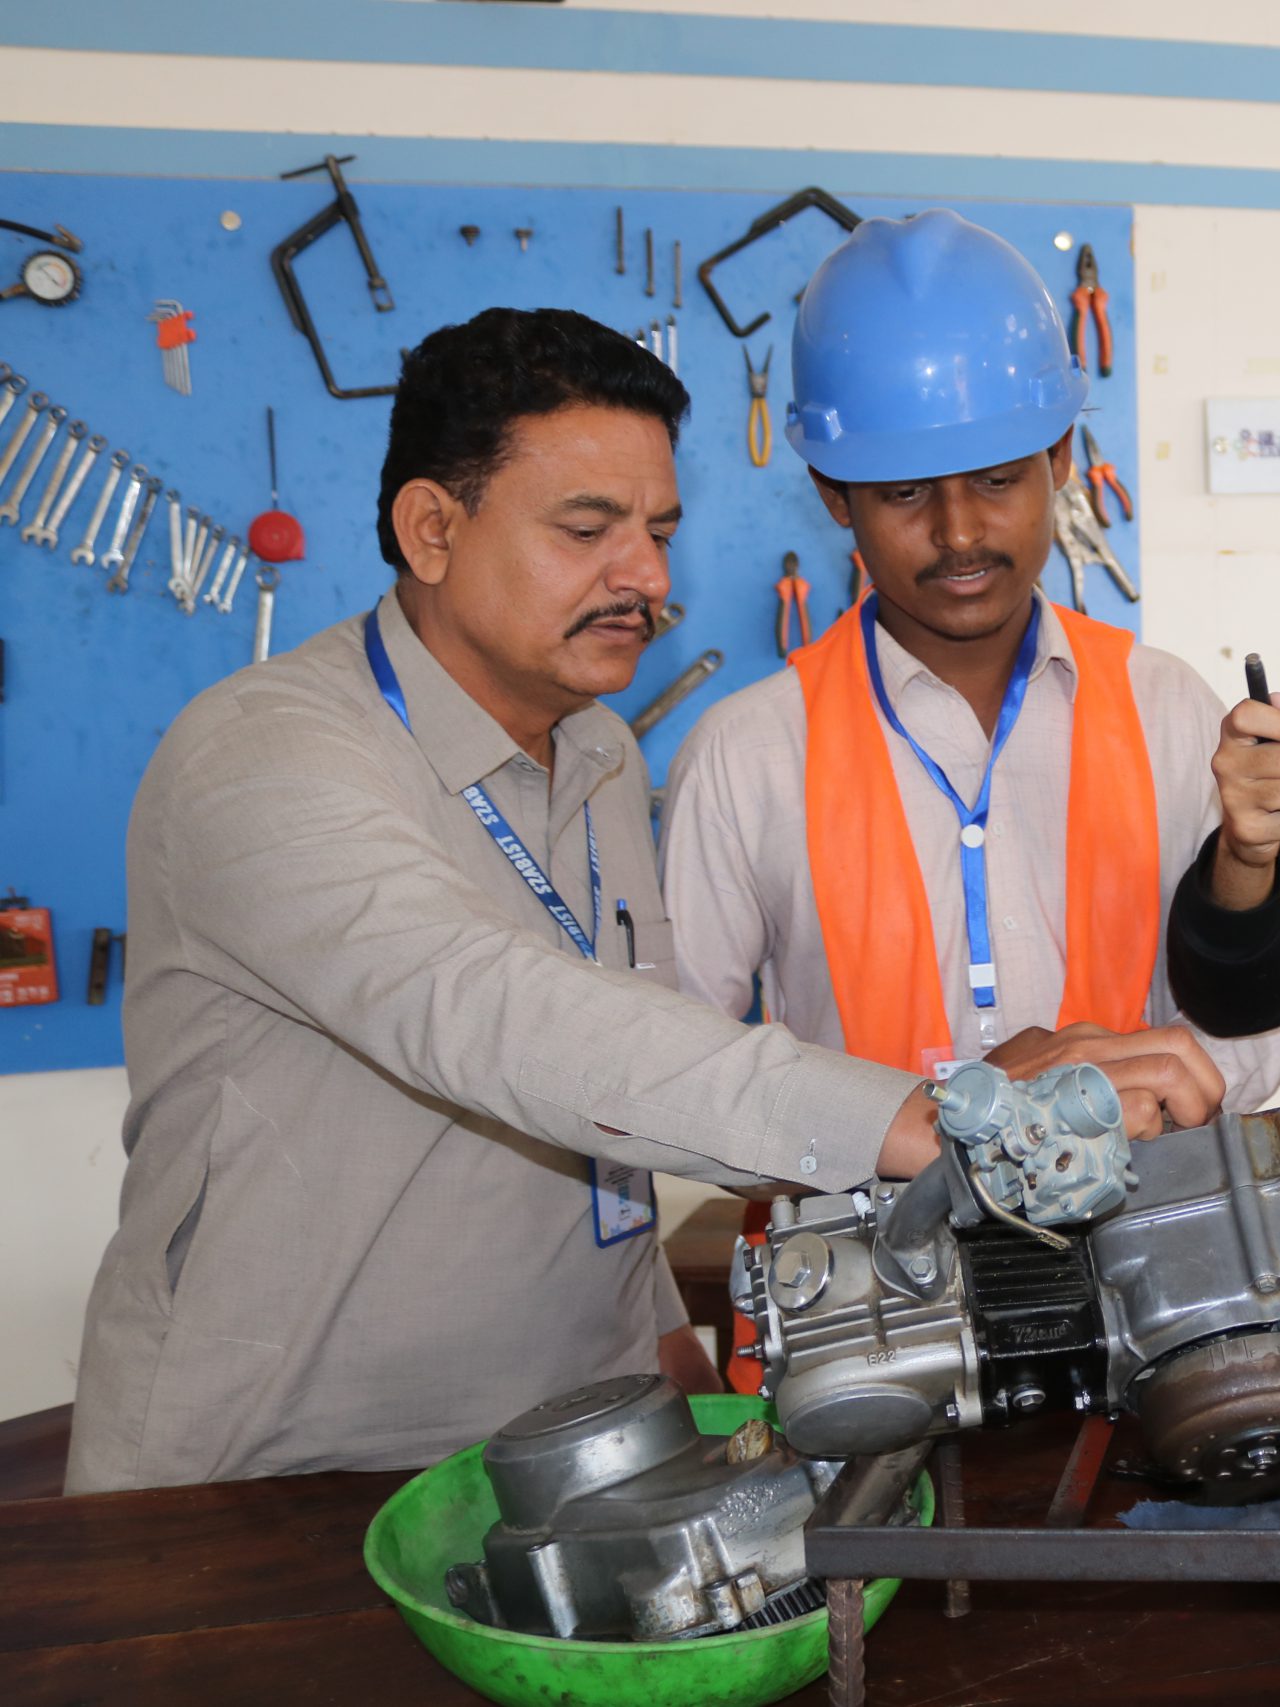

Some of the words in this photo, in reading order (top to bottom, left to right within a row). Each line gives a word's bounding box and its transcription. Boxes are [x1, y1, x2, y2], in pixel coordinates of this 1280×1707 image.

[463, 786, 499, 825] SZAB
[496, 835, 554, 895] SZABIST
[867, 1350, 896, 1367] E22
